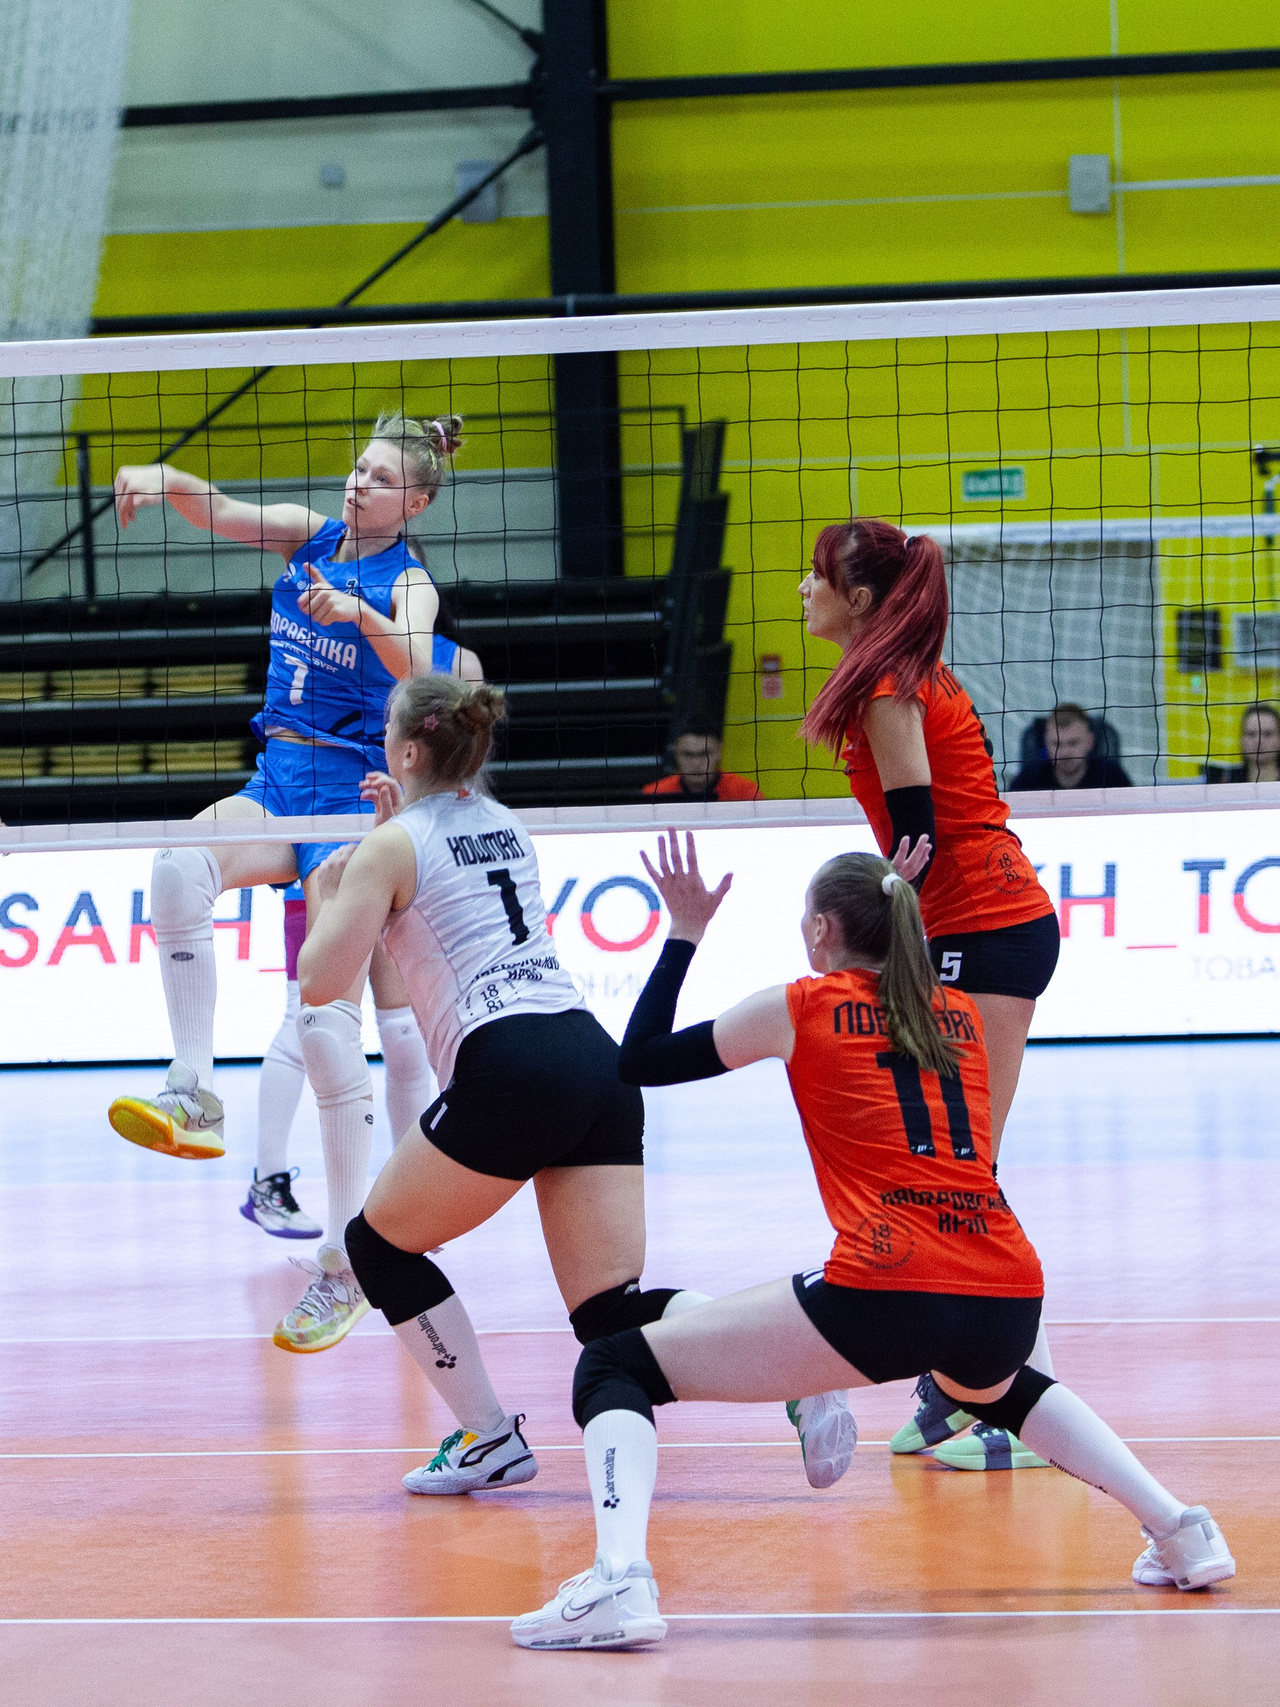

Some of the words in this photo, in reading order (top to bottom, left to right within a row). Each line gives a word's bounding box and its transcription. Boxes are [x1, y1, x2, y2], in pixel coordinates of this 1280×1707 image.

[283, 653, 309, 705] 7
[486, 868, 530, 946] 1
[939, 951, 963, 982] 5
[480, 984, 499, 1002] 18
[486, 999, 505, 1014] 81
[875, 1050, 977, 1162] 11
